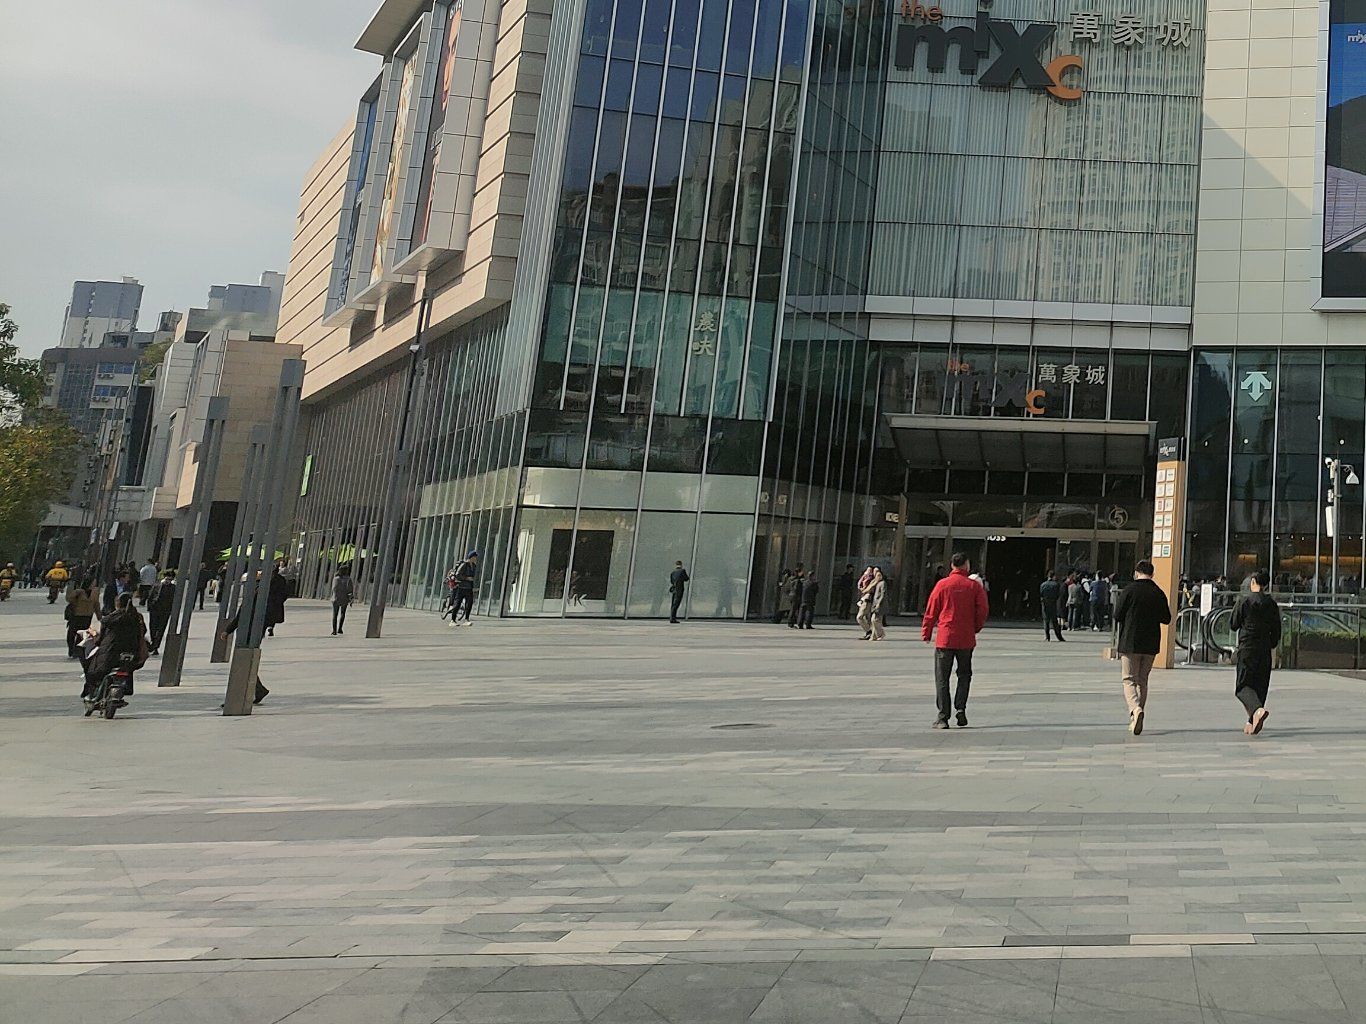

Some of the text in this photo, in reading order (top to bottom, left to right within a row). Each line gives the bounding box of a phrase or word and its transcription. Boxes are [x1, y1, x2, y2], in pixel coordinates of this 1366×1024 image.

[1068, 10, 1192, 48] 萬象城
[1038, 363, 1106, 385] 萬象城
